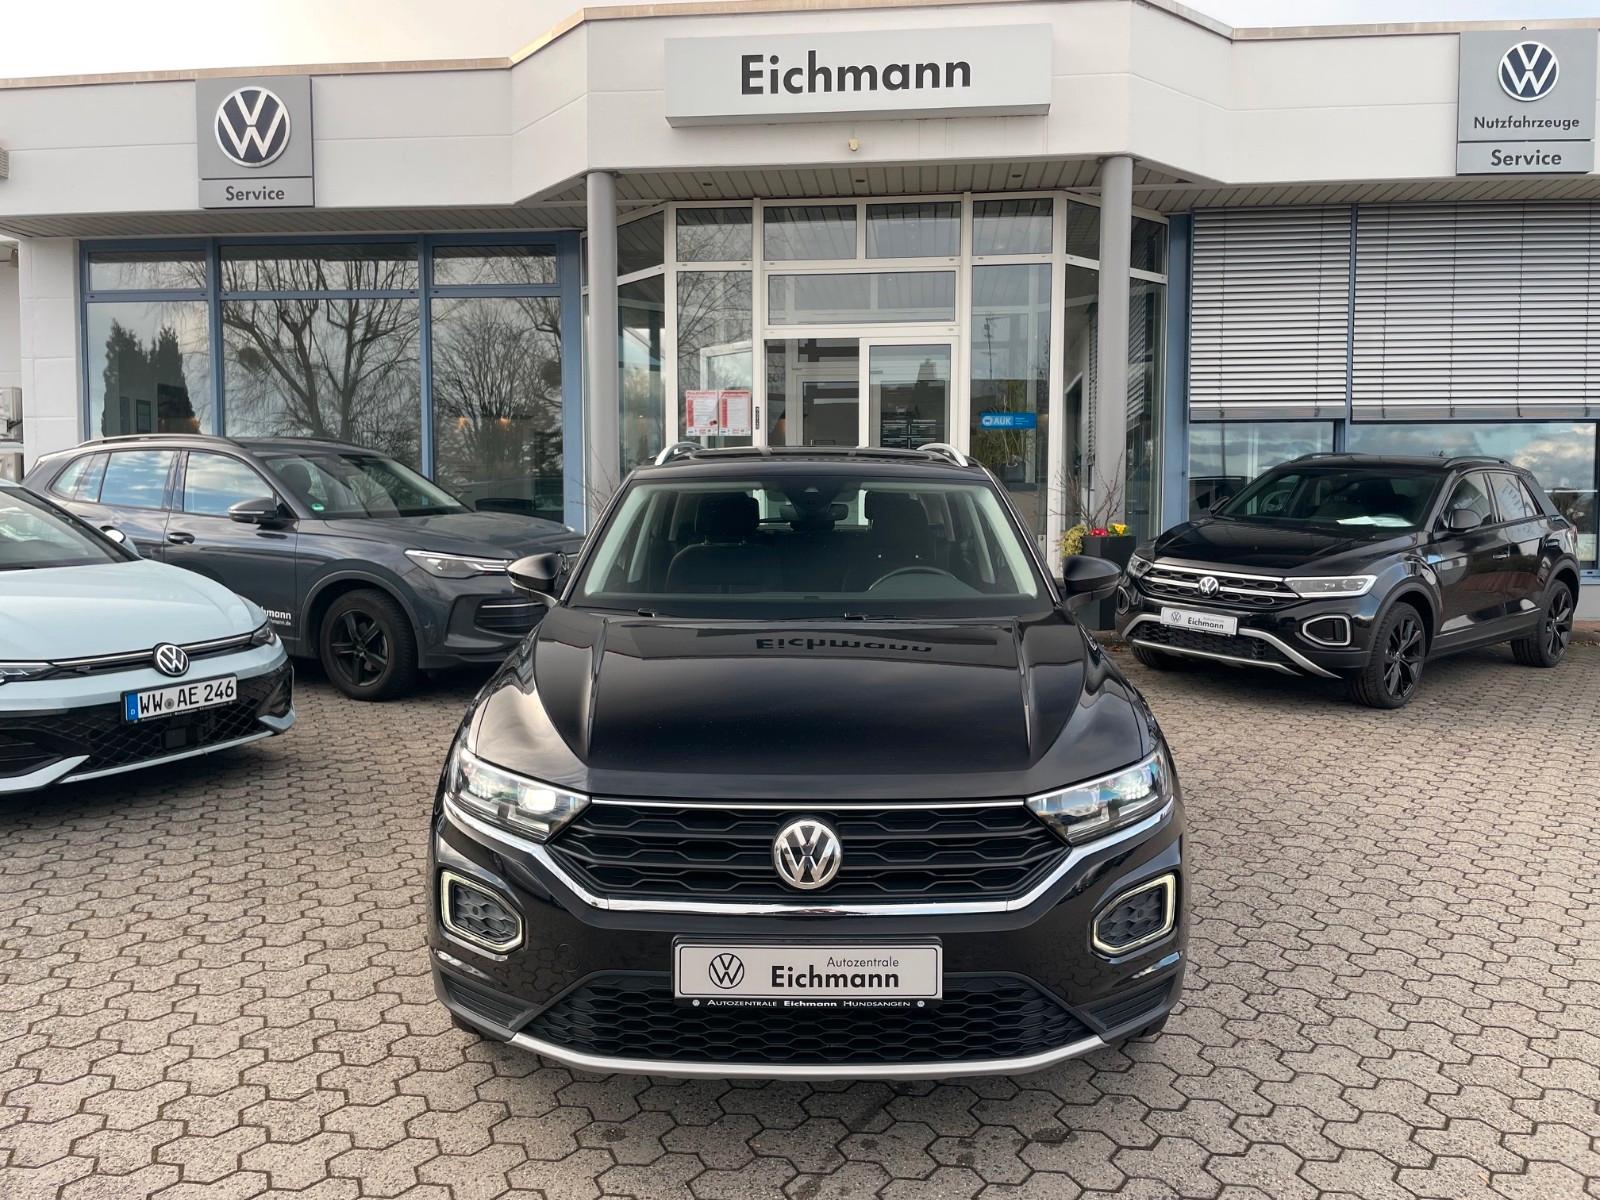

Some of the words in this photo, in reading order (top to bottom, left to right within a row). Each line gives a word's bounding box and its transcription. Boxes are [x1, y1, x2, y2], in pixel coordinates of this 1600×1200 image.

[741, 49, 971, 95] Eichmann
[1473, 115, 1580, 131] Nutzfahrzeuge
[1490, 149, 1562, 167] Service
[225, 185, 285, 201] Service
[993, 415, 1012, 425] AUK
[1187, 616, 1224, 630] Eichmann
[139, 692, 163, 715] WW
[177, 686, 200, 708] AE
[203, 679, 234, 702] 246
[826, 955, 900, 968] Autozentrale
[771, 964, 900, 989] Eichmann
[706, 999, 778, 1008] AUTOZENTRALE
[783, 1000, 838, 1008] Eichmann
[843, 1000, 912, 1008] HUNDSANGEN
